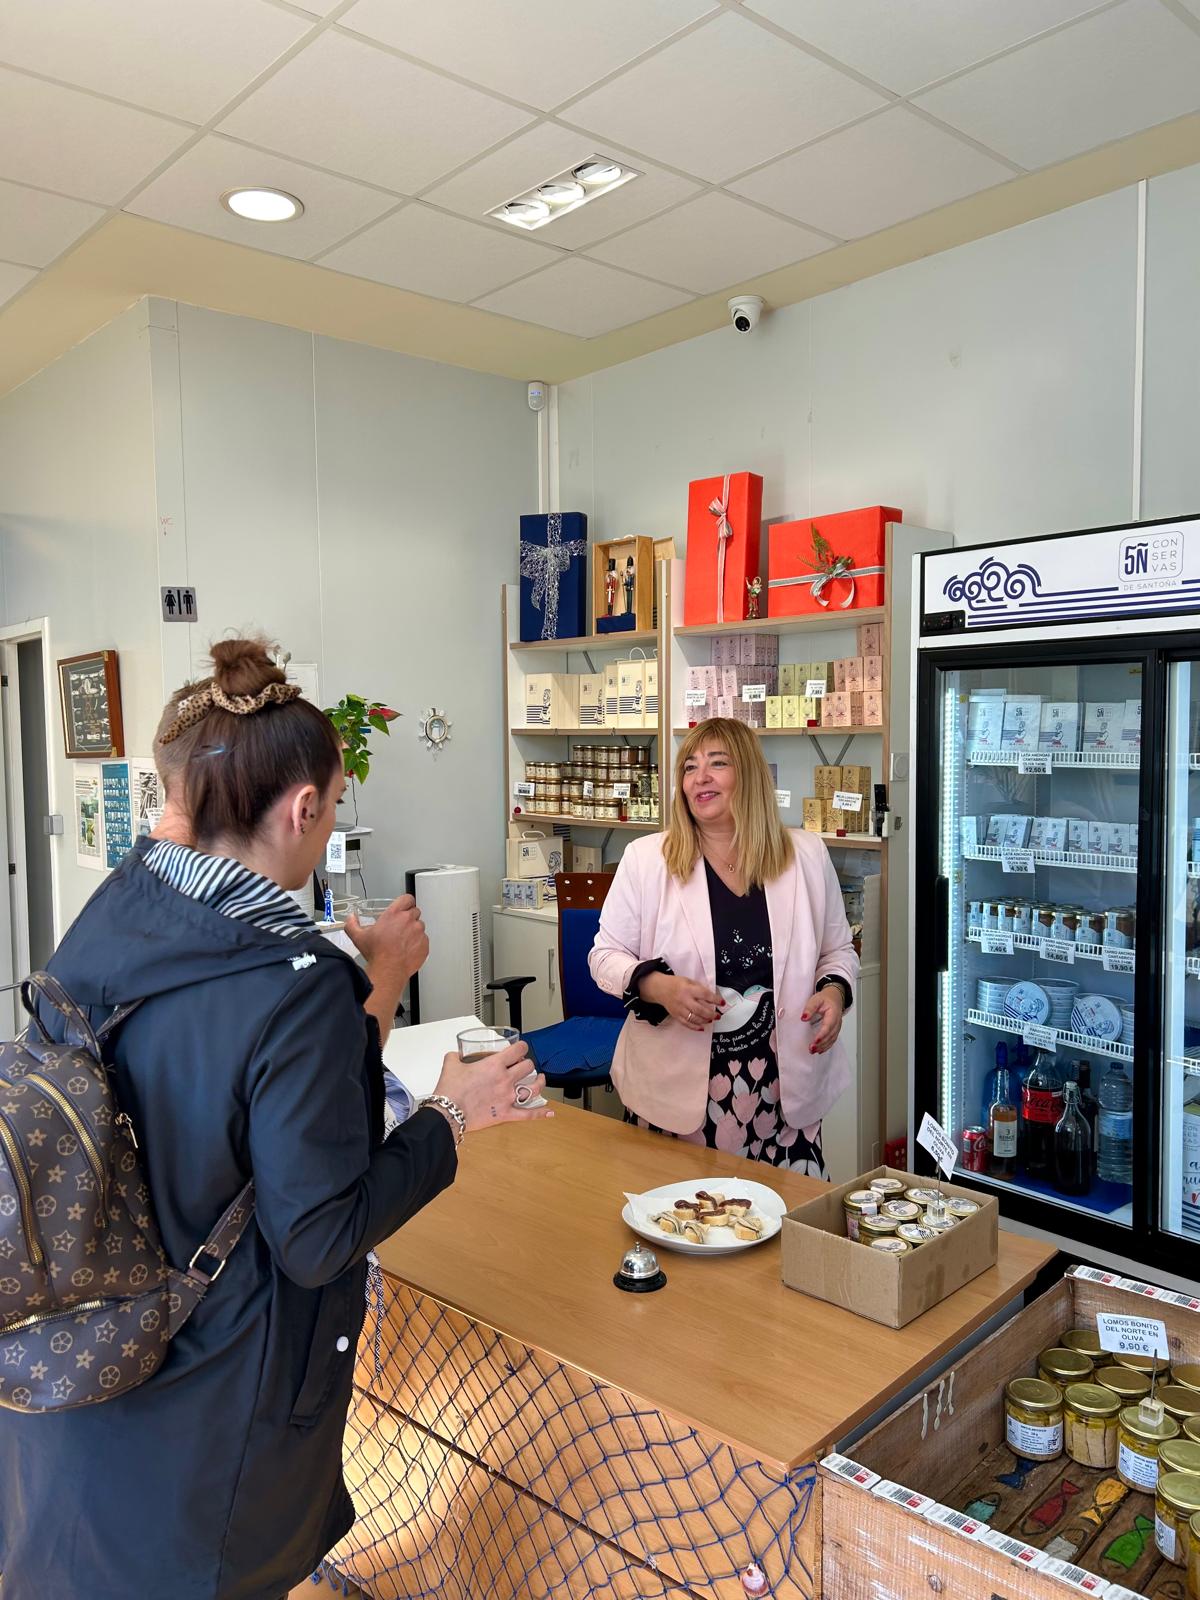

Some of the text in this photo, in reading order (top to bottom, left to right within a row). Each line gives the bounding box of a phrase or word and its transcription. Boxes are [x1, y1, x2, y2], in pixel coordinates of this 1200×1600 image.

[1152, 538, 1178, 549] CON
[1152, 550, 1177, 561] SER
[1152, 561, 1177, 572] VAS
[1137, 579, 1177, 590] SANTOÑA
[1102, 1318, 1159, 1331] LOMOS BONITO
[1121, 1327, 1147, 1336] NORTE
[1121, 1334, 1145, 1342] OLIVA
[1119, 1341, 1149, 1352] 9,90 €
